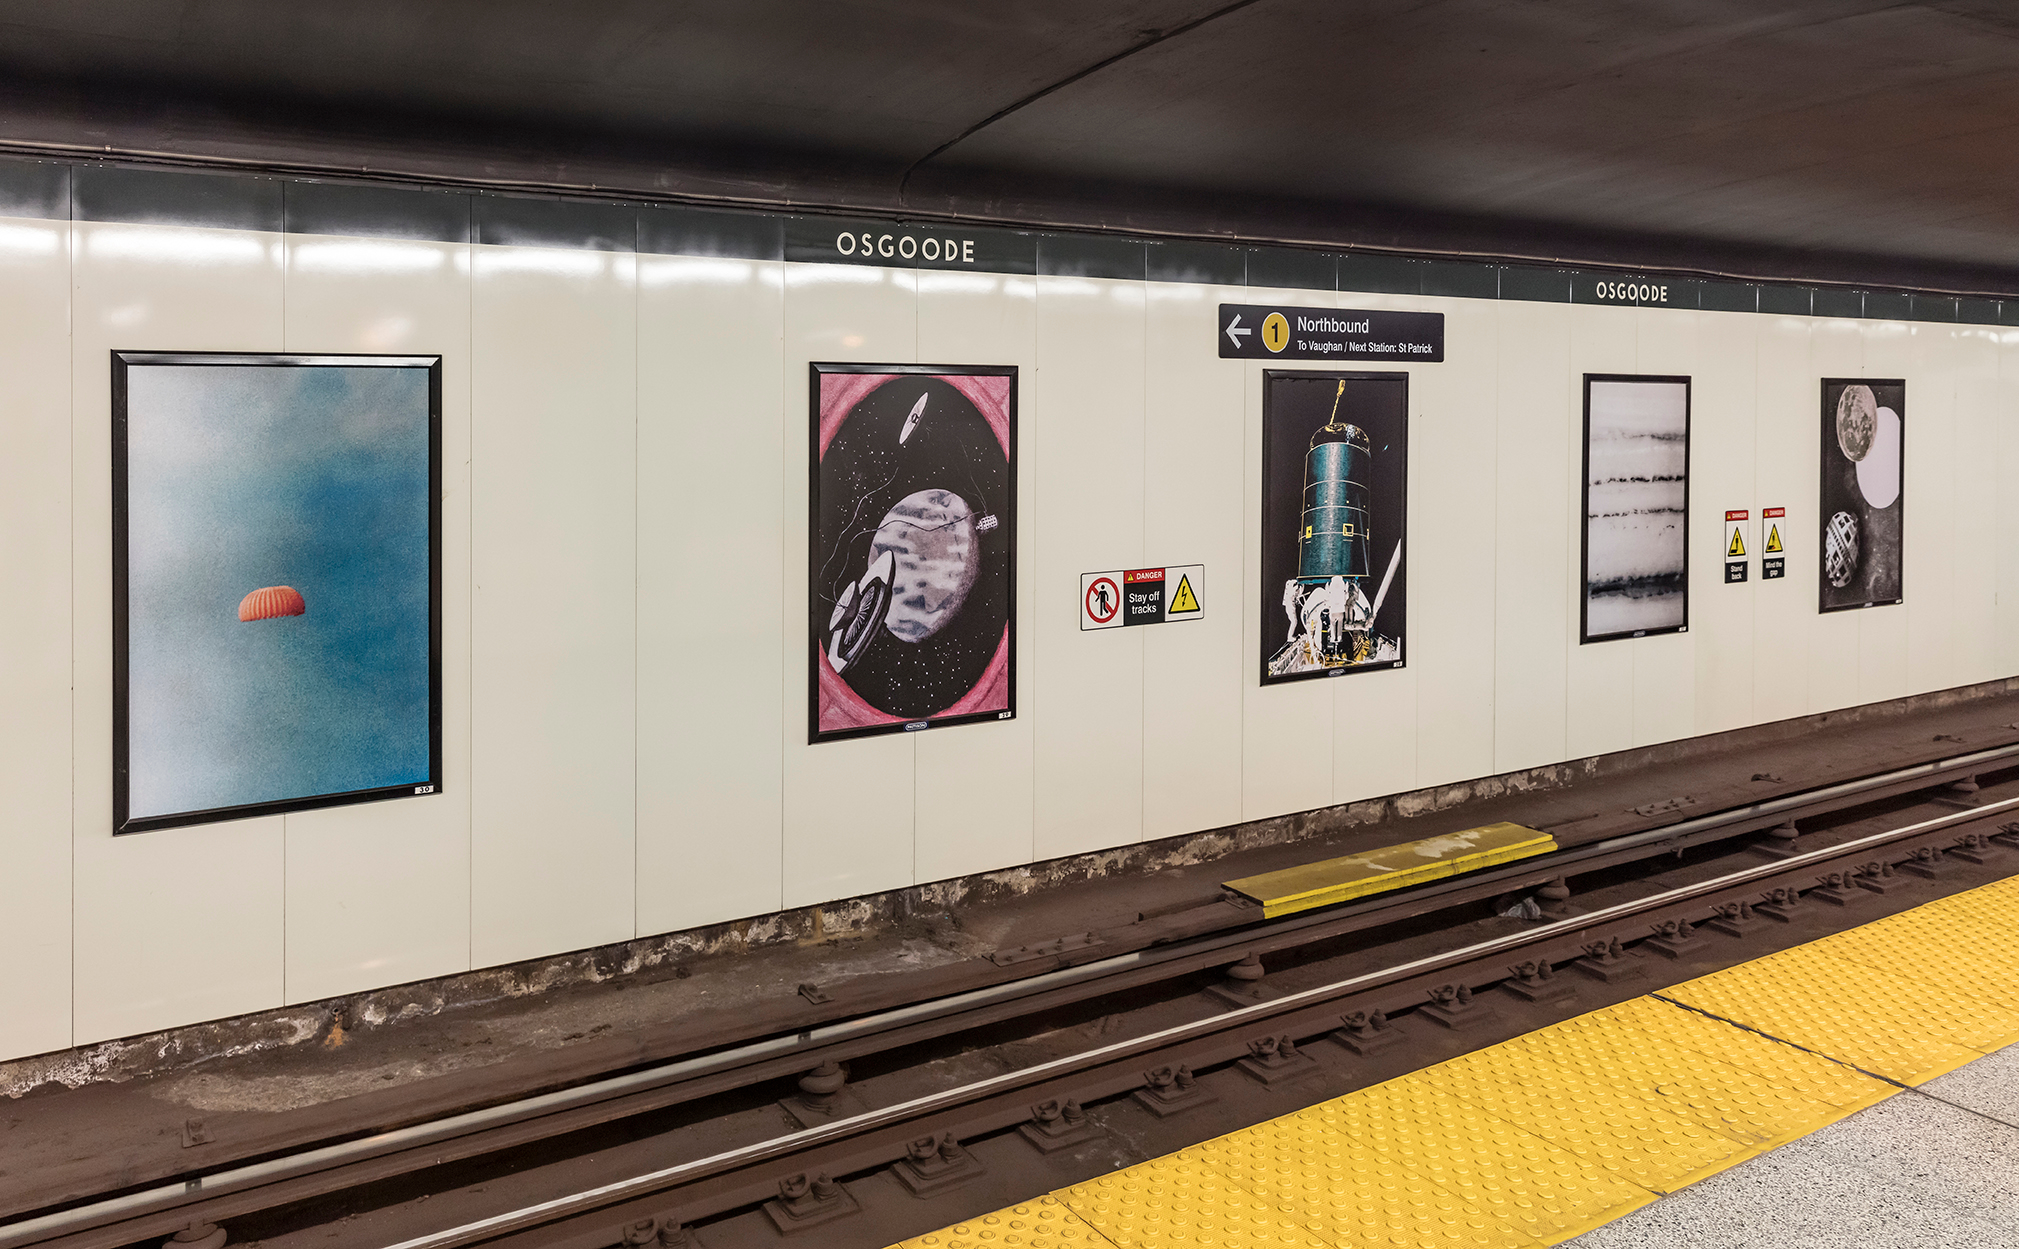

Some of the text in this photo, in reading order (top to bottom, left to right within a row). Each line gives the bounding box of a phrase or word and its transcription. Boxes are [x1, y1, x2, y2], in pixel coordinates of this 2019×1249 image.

[836, 231, 975, 263] OSGOODE
[1596, 281, 1668, 302] OSGOODE
[1271, 322, 1279, 343] 1
[1297, 316, 1369, 334] Northbound
[1297, 340, 1433, 354] To Vaughan / Next Station: St Patrick
[1136, 571, 1163, 580] DANGER
[1128, 590, 1160, 604] Stay off
[1131, 604, 1157, 615] tracks
